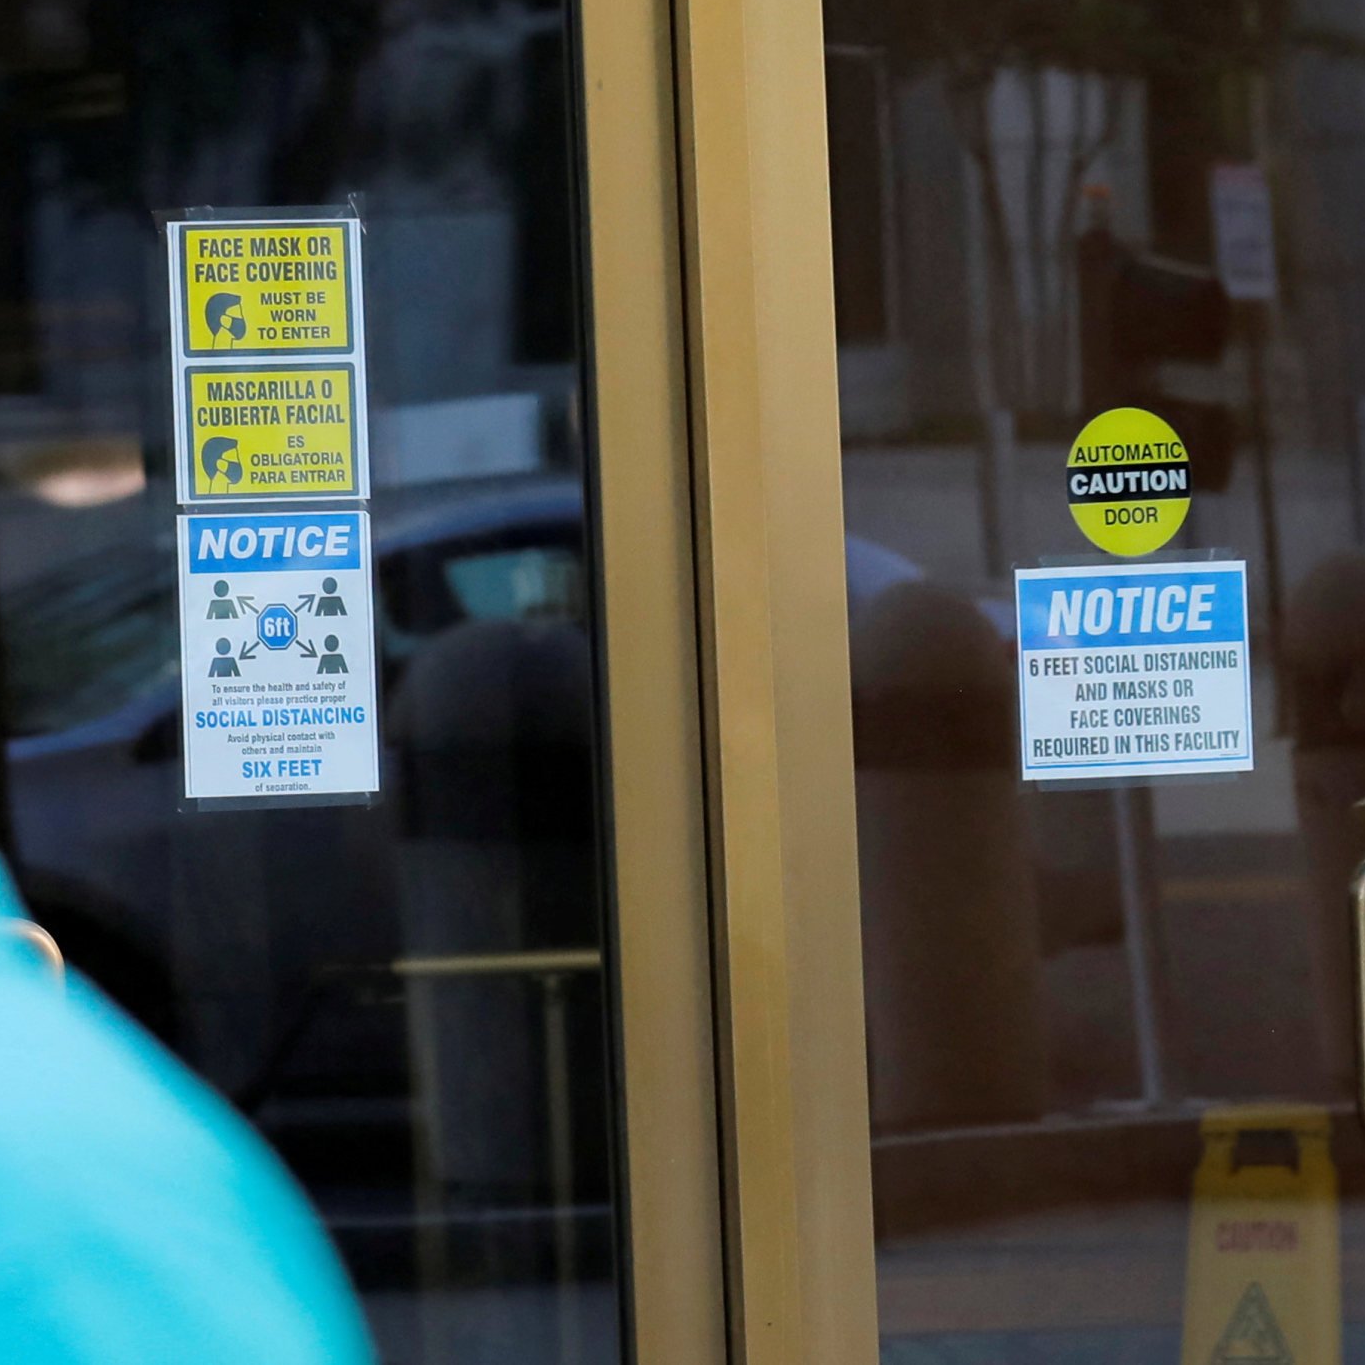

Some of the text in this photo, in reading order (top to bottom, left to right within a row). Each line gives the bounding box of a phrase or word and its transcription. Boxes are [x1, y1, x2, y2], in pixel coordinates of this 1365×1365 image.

[199, 236, 331, 258] FACE MASK OR
[195, 261, 337, 283] FACE COVERING
[260, 292, 326, 305] MUST BE
[270, 310, 316, 322] WORN
[257, 327, 330, 340] TO ENTER
[207, 379, 332, 401] MASCARILLA O
[197, 404, 345, 427] CUBIERTA FACIAL
[287, 436, 304, 448] ES
[251, 452, 343, 467] OBLIGATORIA
[1075, 442, 1182, 463] AUTOMATIC
[250, 470, 345, 484] PARA ENTRAR
[1070, 469, 1187, 495] CAUTION
[1105, 507, 1158, 526] DOOR
[198, 525, 351, 559] NOTICE
[1047, 584, 1215, 636] NOTICE
[264, 618, 291, 637] 6ft
[1029, 650, 1237, 676] 6 FEET SOCIAL DISTANCING
[212, 681, 346, 694] To ensure the health and safety of
[1075, 679, 1194, 701] AND MASKS OR
[212, 695, 346, 707] all visitors please practice proper
[195, 707, 365, 728] SOCIAL DISTANCING
[1070, 705, 1201, 729] FACE COVERINGS
[227, 732, 335, 744] Avoid physical contact with
[1033, 730, 1240, 758] REQUIRED IN THIS FACILITY
[242, 744, 322, 755] others and maintain
[242, 759, 322, 779] SIX FEET
[255, 783, 263, 792] of
